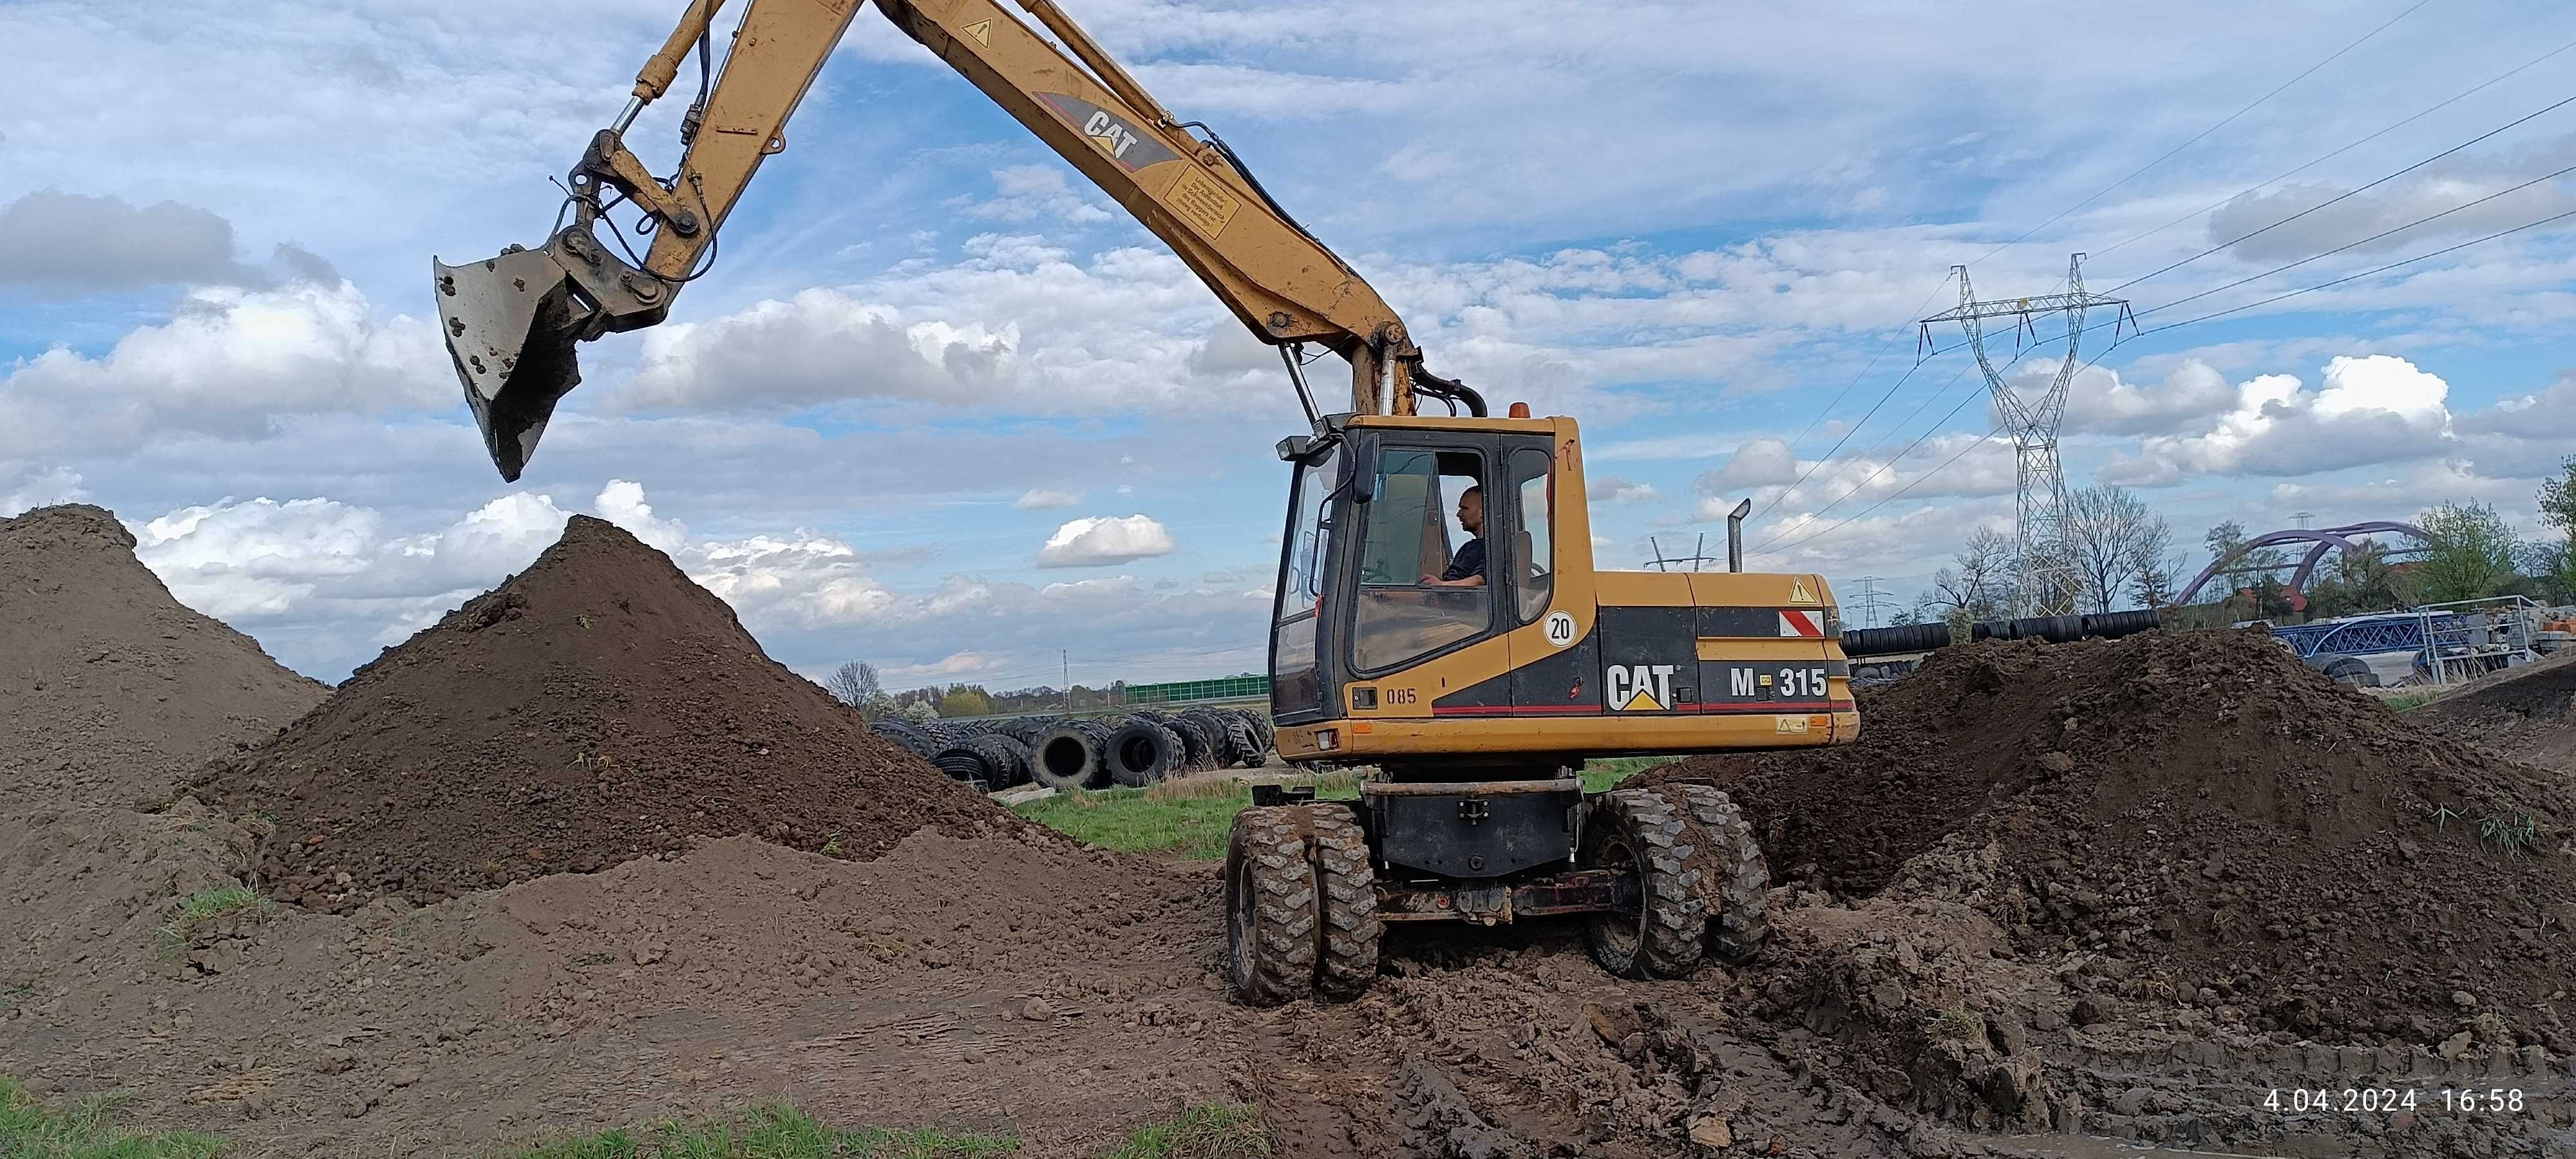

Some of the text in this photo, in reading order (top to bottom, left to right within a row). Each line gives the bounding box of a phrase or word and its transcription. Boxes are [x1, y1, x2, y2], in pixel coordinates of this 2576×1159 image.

[1084, 111, 1137, 159] CAT
[1551, 618, 1569, 639] 20
[1387, 688, 1417, 704] 085
[1607, 665, 1674, 711] CAT
[1730, 668, 1826, 697] M 315
